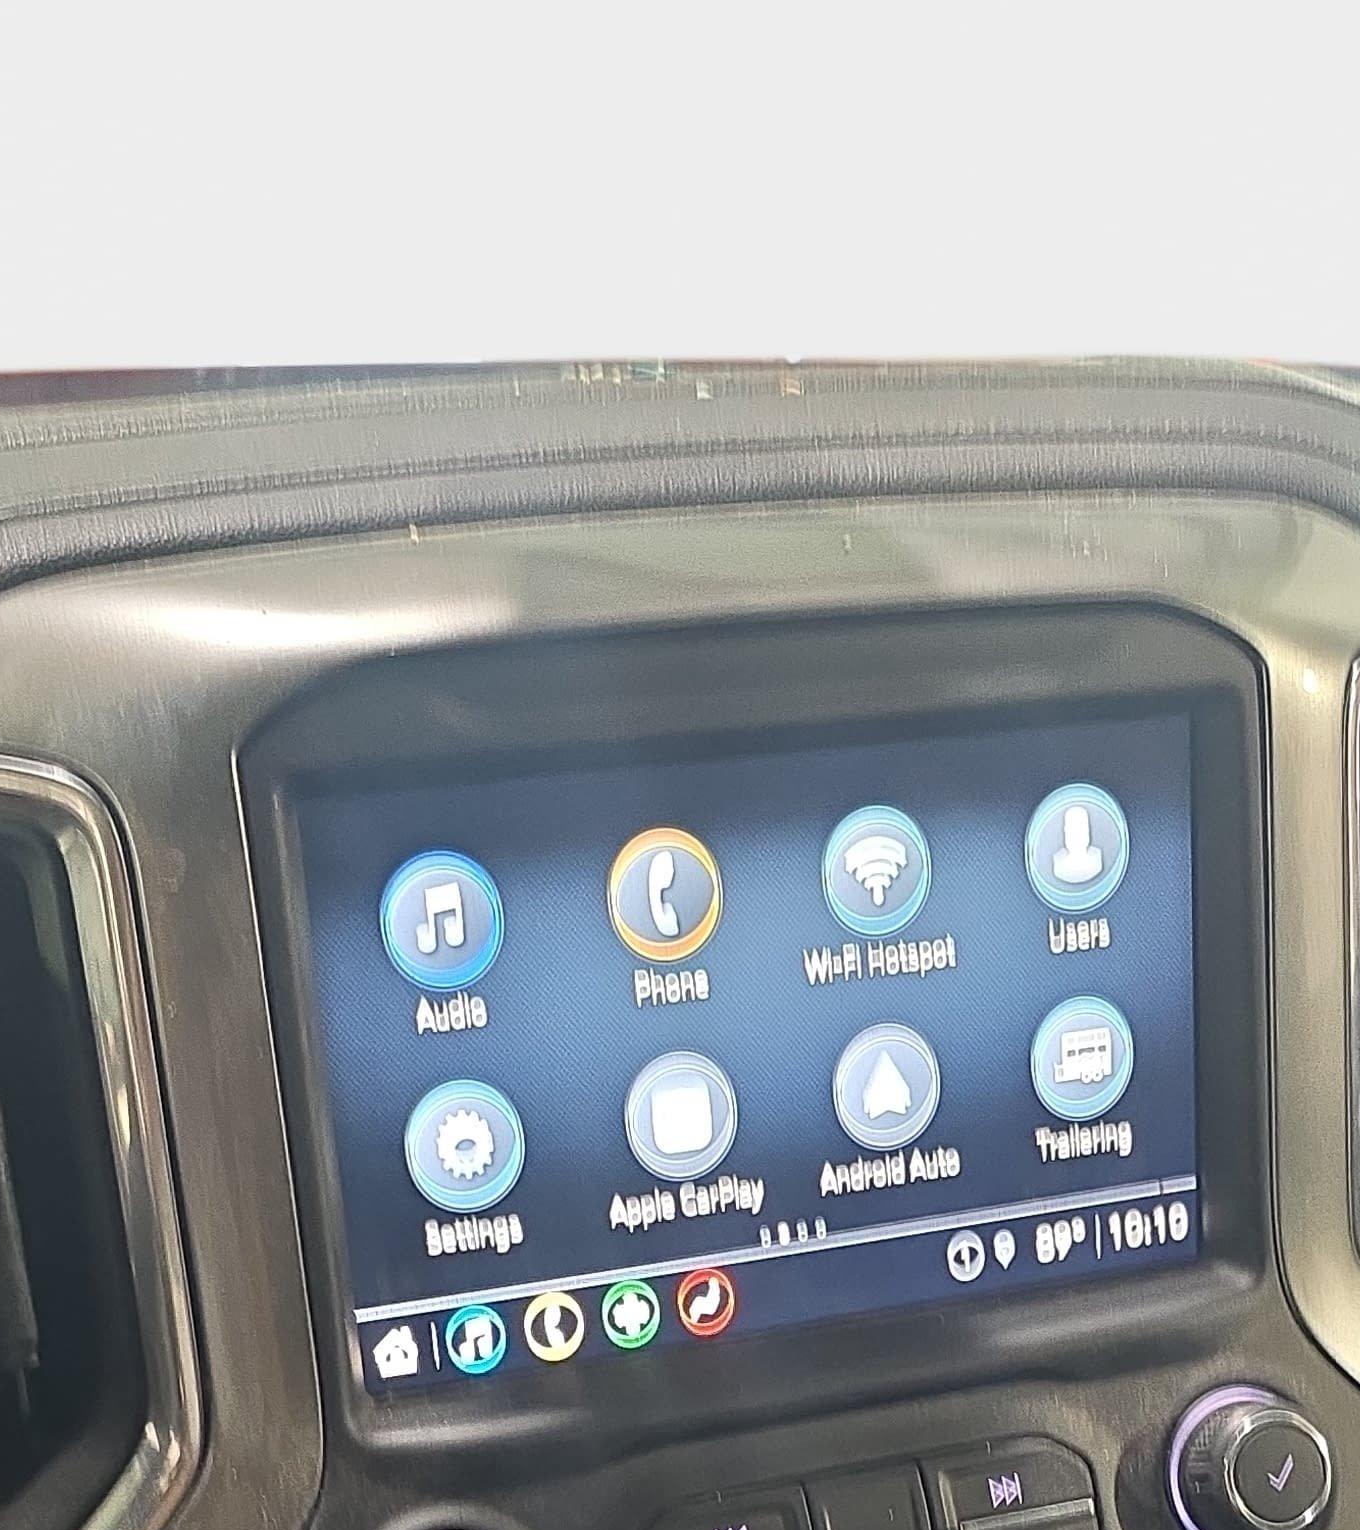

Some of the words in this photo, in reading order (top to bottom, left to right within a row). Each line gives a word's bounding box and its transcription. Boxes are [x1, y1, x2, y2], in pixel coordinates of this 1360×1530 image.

[868, 933, 957, 978] Hotspot
[1049, 917, 1111, 954] Users
[634, 967, 710, 1008] Phone
[416, 991, 488, 1035] Audio
[1035, 1120, 1133, 1163] Trailering
[819, 1156, 905, 1198] Android
[909, 1146, 961, 1180] Auto
[609, 1185, 676, 1233] Apple
[679, 1173, 765, 1218] CarPlay
[424, 1214, 524, 1257] Settings
